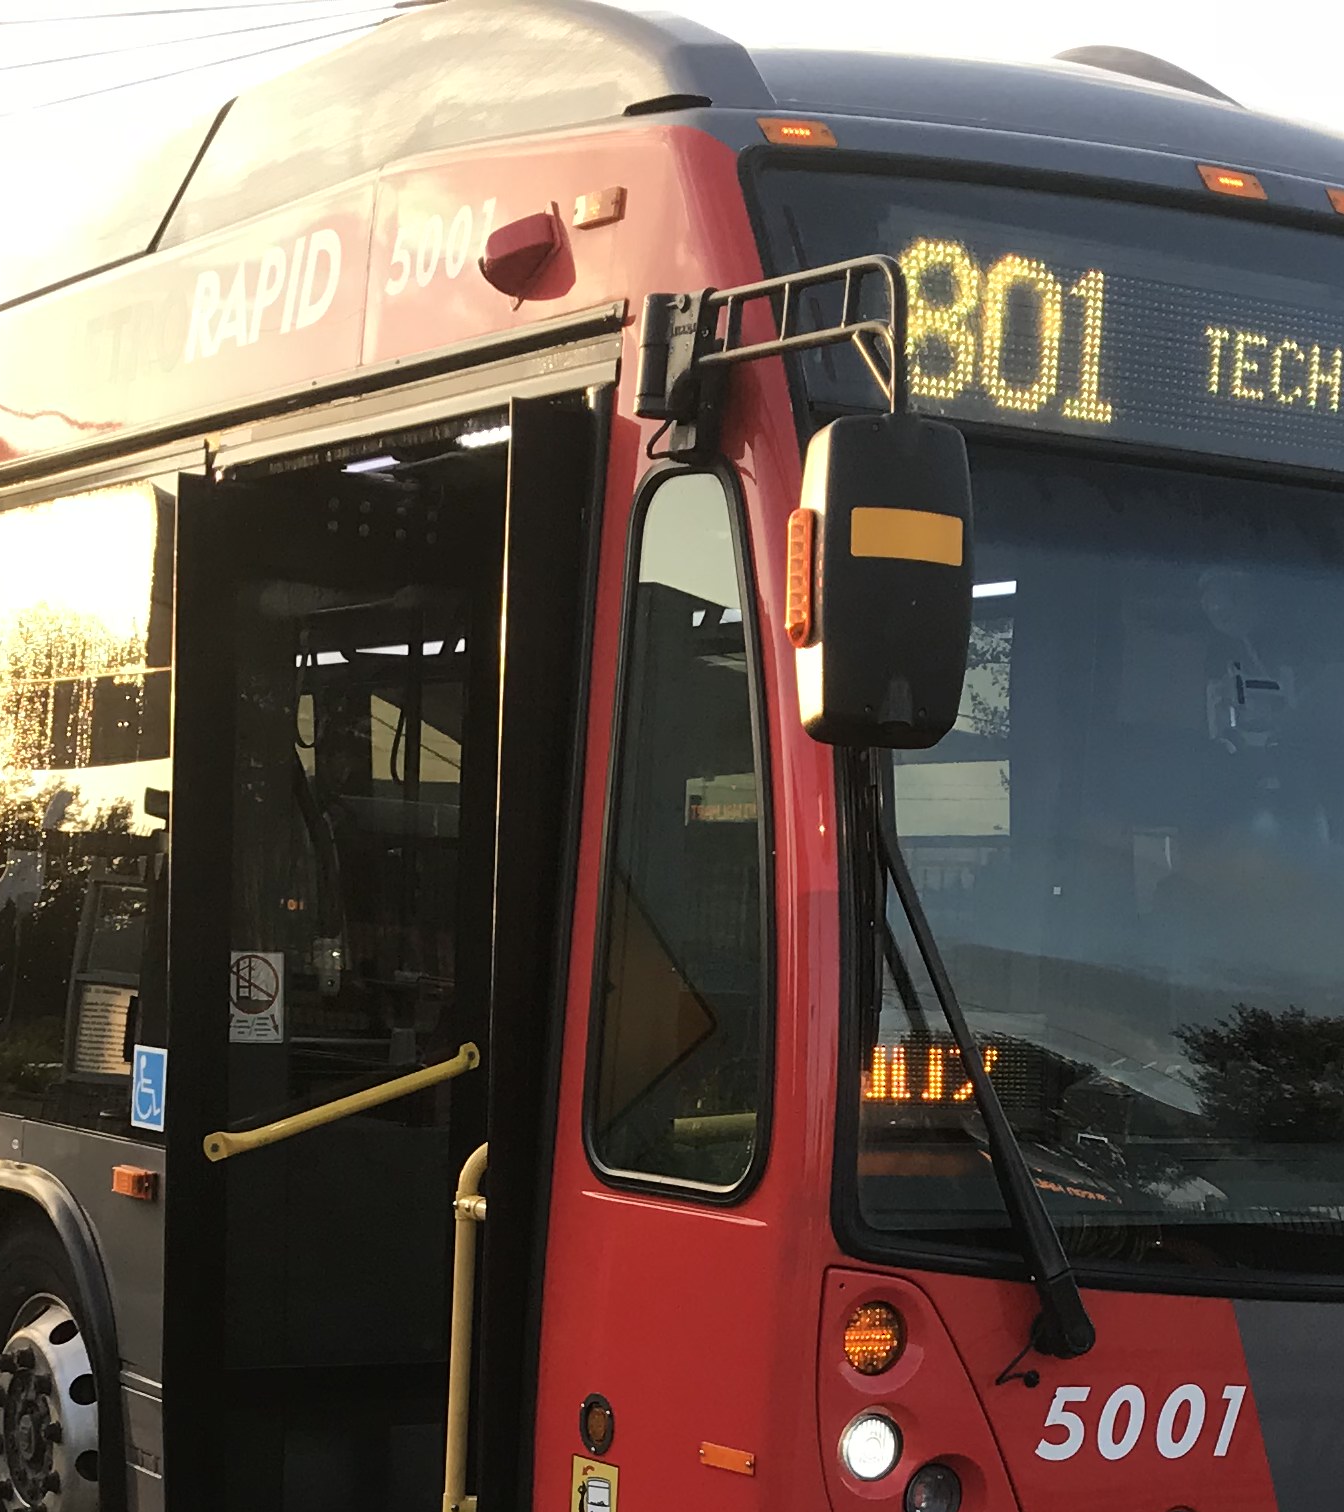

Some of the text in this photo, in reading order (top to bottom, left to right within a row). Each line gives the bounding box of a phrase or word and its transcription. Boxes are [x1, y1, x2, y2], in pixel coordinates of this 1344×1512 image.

[184, 227, 343, 363] RAPID
[899, 237, 1113, 423] 801
[1203, 324, 1344, 413] TECH
[1034, 1383, 1247, 1461] 5001
